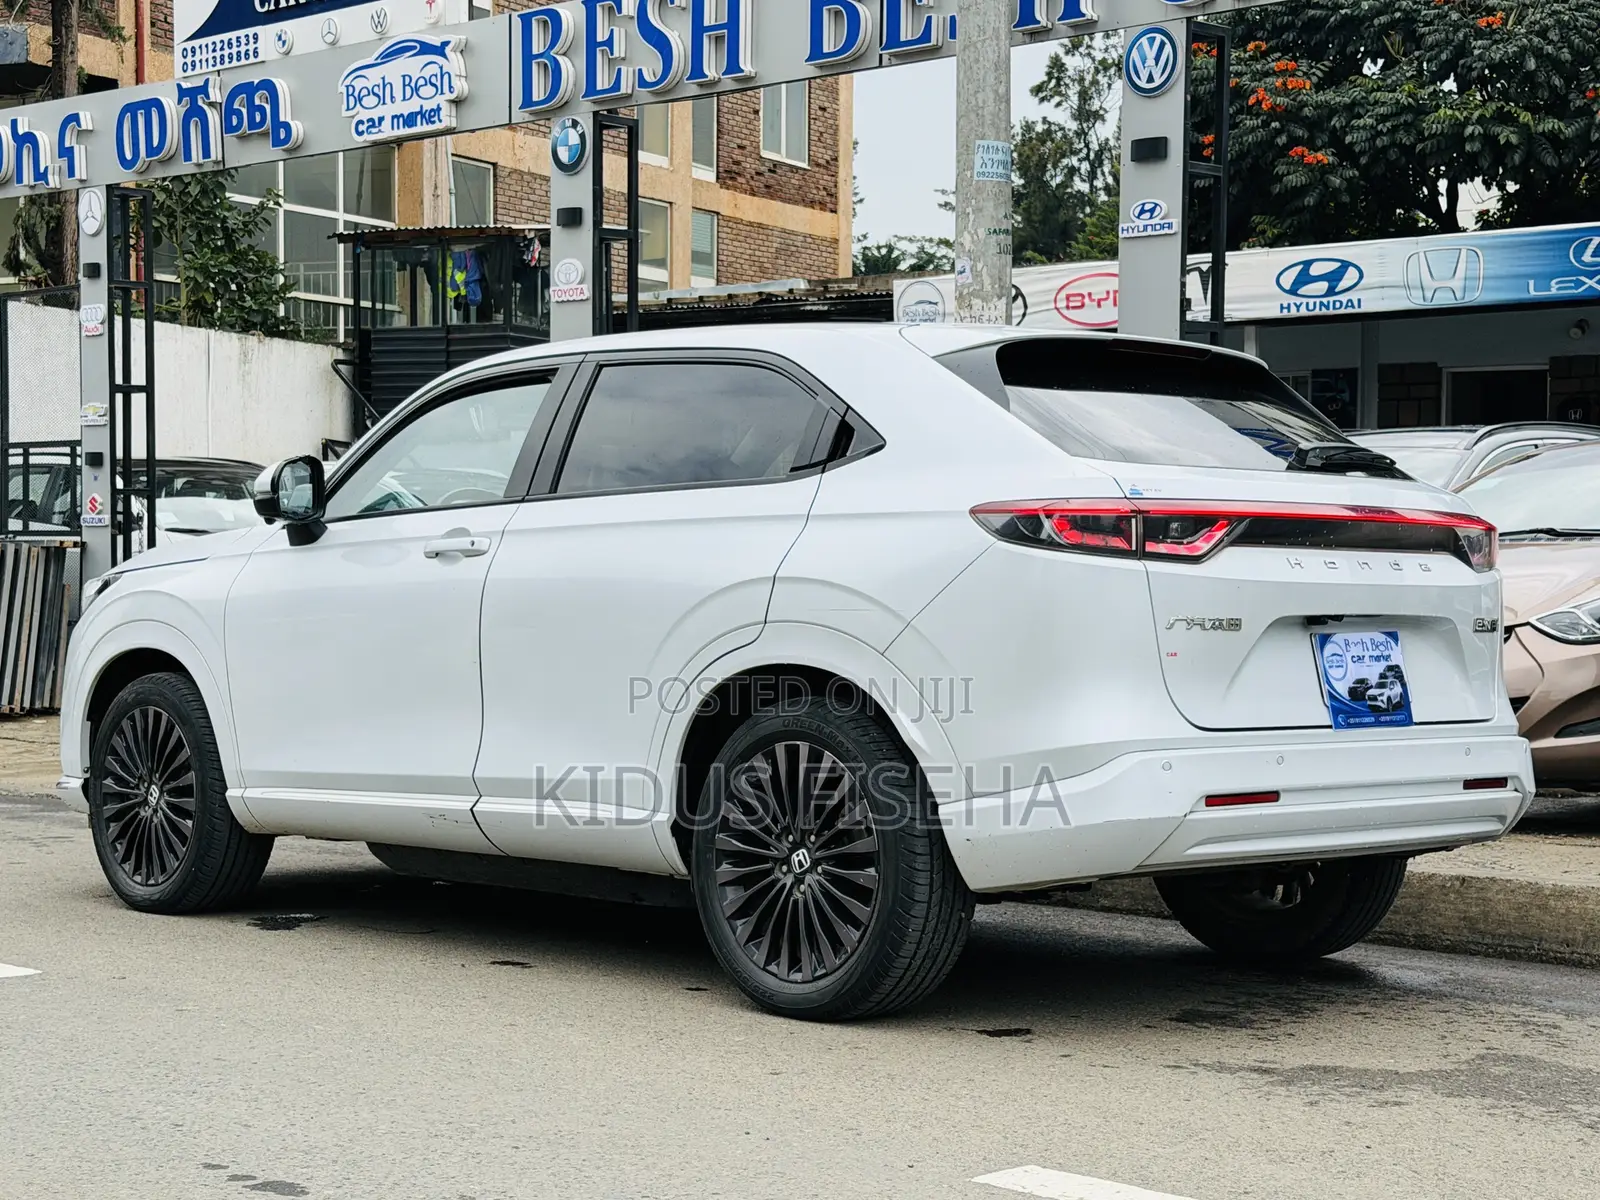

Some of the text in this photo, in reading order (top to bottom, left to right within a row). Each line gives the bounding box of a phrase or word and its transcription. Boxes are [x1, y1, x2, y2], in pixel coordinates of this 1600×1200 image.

[181, 32, 260, 59] 0911226539
[518, 0, 758, 112] BESH
[181, 46, 260, 73] 0911389866
[344, 64, 455, 111] Besh Besh
[354, 103, 443, 136] car market
[0, 76, 300, 189] ኪና መሸጫ
[1120, 221, 1173, 235] HYUNDAI
[551, 288, 585, 299] TOYOTA
[1064, 289, 1119, 311] BY
[1279, 298, 1362, 314] HYUNDAI
[82, 516, 106, 525] SUZUKI
[1371, 637, 1394, 652] Besh
[1351, 654, 1366, 664] car
[1369, 653, 1393, 664] market
